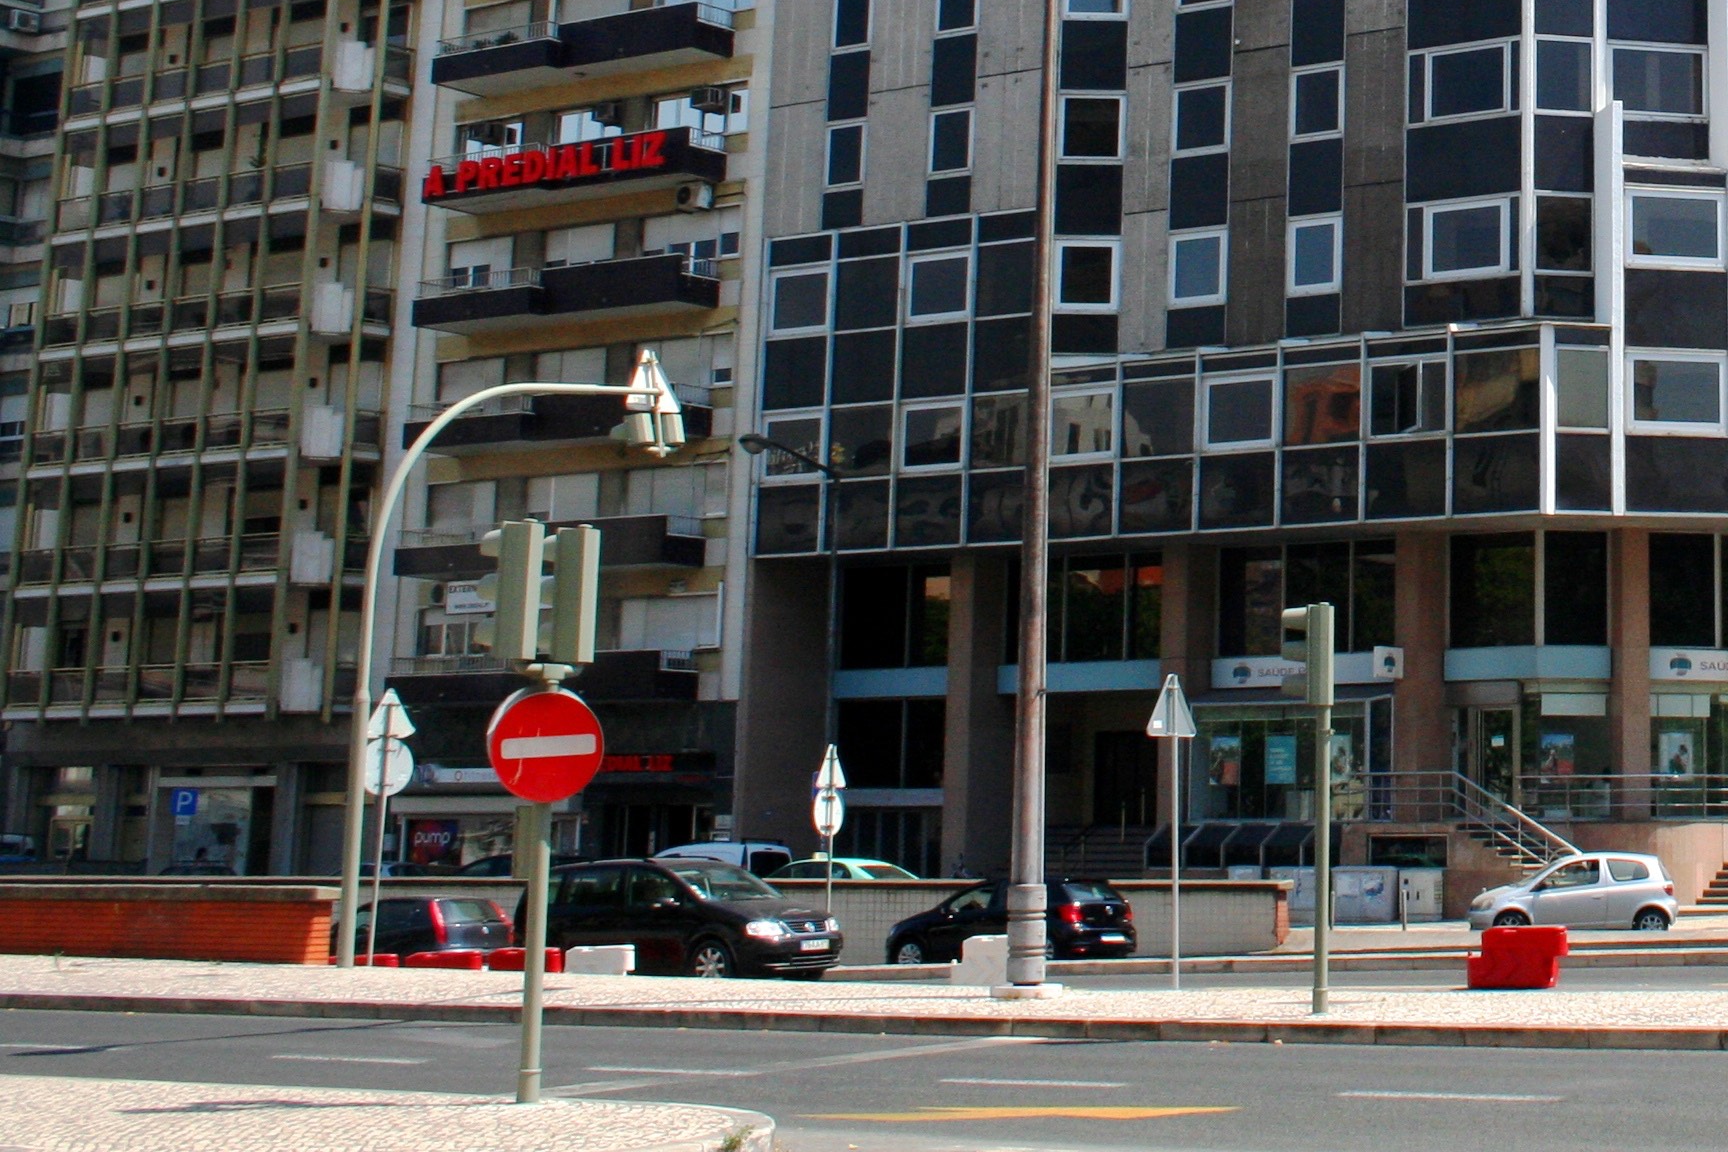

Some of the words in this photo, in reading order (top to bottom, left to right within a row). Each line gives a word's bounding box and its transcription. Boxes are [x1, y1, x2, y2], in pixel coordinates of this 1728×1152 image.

[425, 165, 446, 198] A
[455, 142, 600, 193] PREDIAL
[611, 131, 667, 171] LIZ
[176, 791, 193, 813] P
[414, 829, 449, 845] pump
